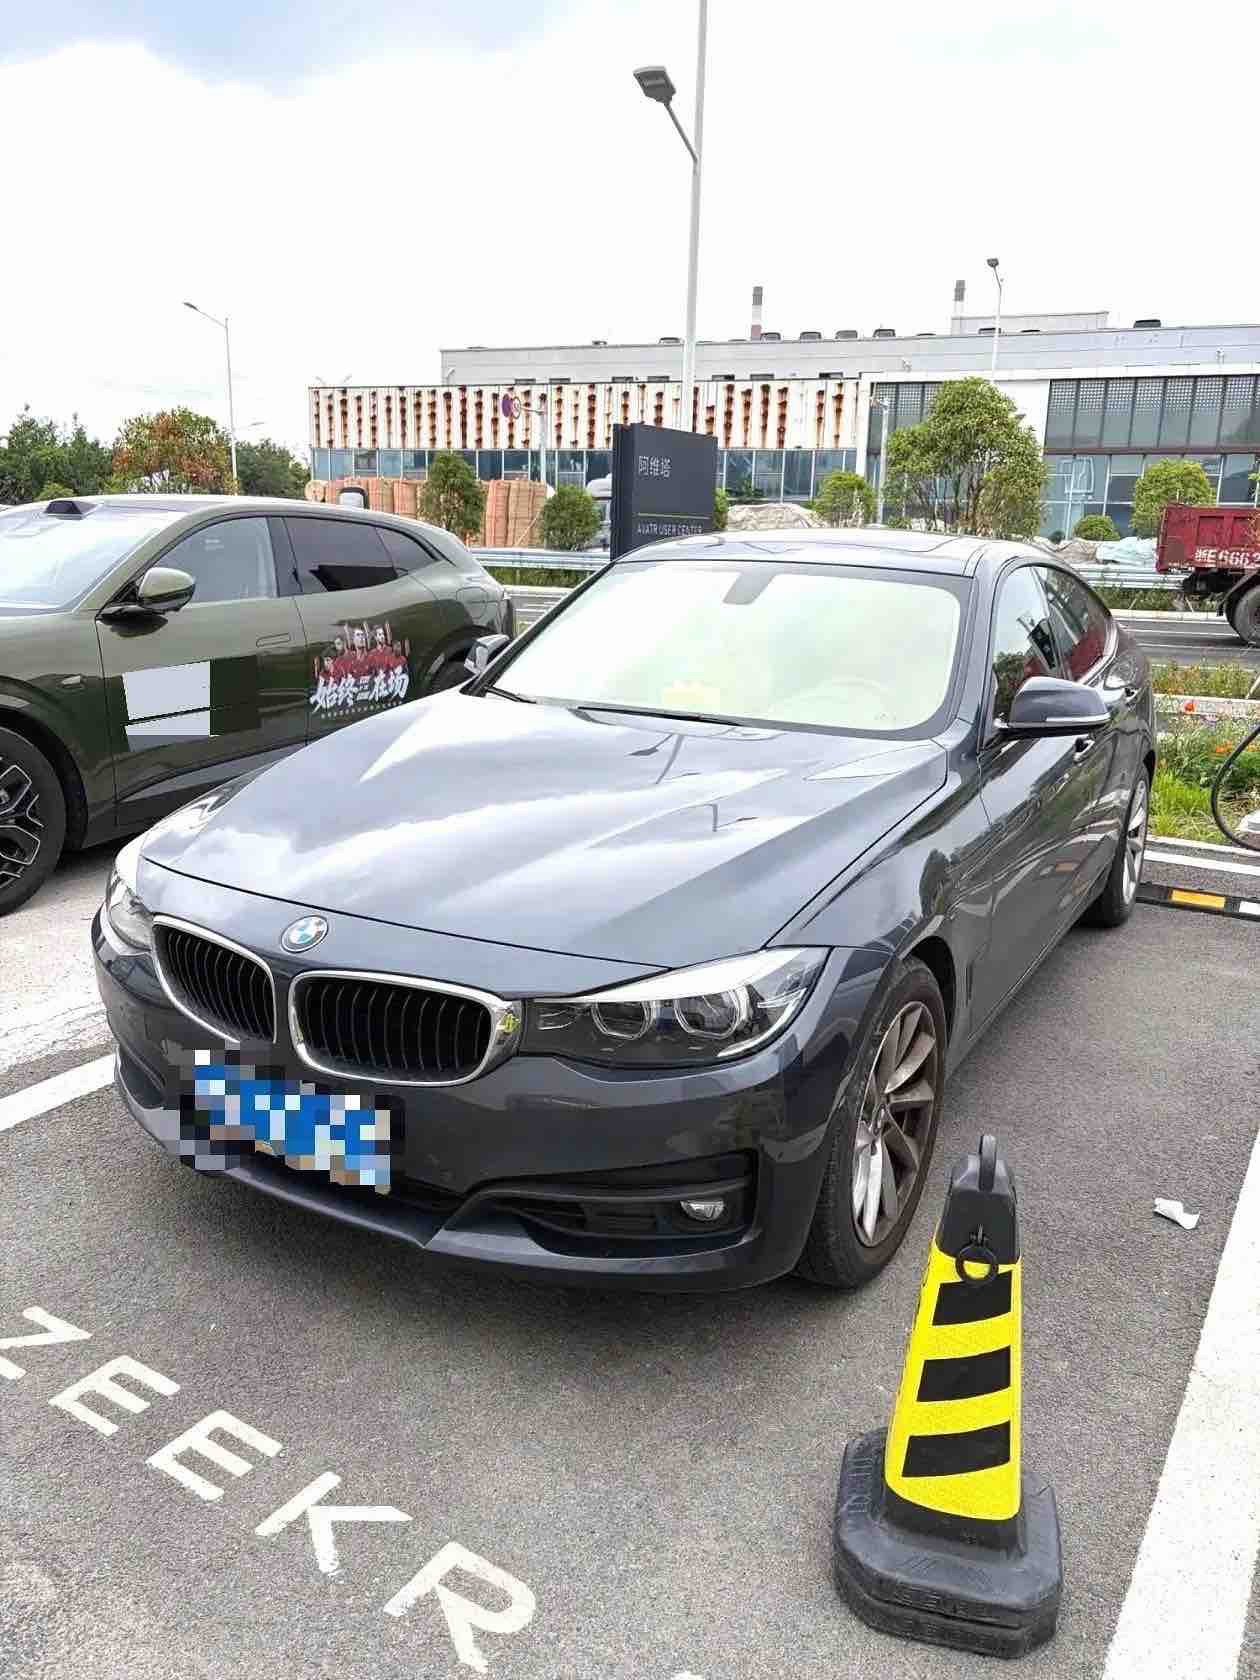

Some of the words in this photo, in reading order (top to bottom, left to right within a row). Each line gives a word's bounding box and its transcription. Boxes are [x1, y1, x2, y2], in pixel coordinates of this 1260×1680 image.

[639, 455, 672, 478] 阿维塔
[637, 523, 658, 535] AVATR
